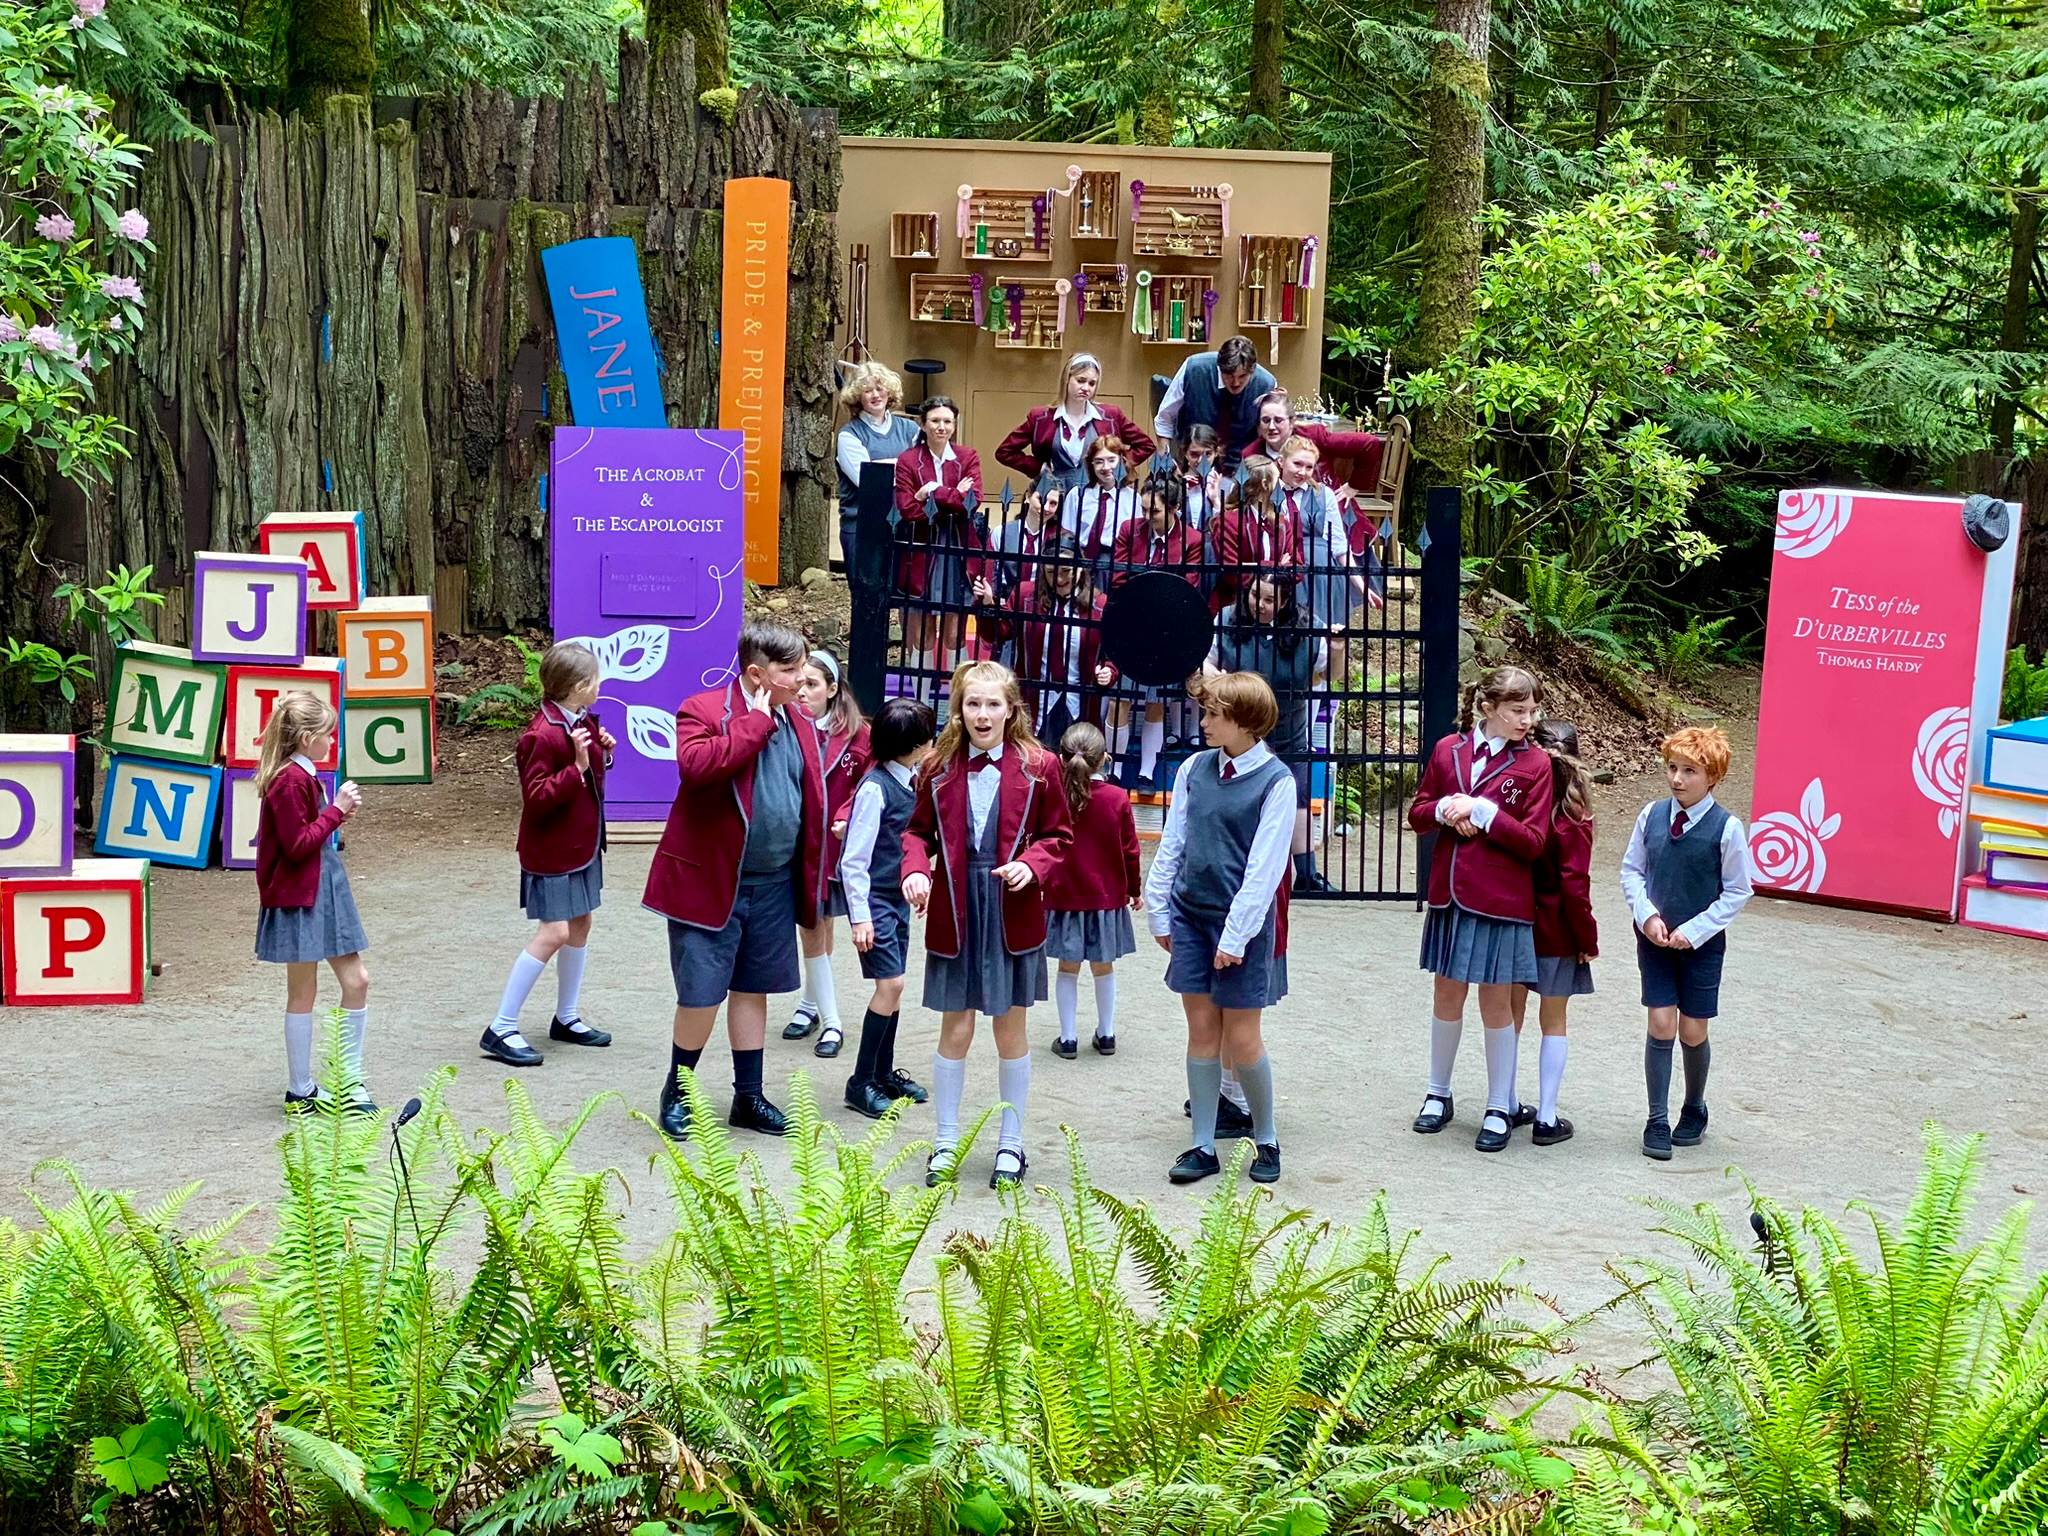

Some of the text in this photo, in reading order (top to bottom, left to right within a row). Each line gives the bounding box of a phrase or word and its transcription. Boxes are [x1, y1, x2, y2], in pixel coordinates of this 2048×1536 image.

[744, 220, 766, 307] PRIDE
[569, 285, 637, 413] JANE
[743, 317, 762, 336] &
[640, 492, 653, 506] &
[299, 542, 337, 592] A
[226, 583, 274, 642] J
[1878, 596, 1898, 617] of
[1896, 598, 1920, 615] the
[362, 629, 409, 679] B
[128, 673, 202, 740] M
[363, 716, 406, 765] C
[123, 777, 195, 842] N
[40, 906, 106, 979] P
